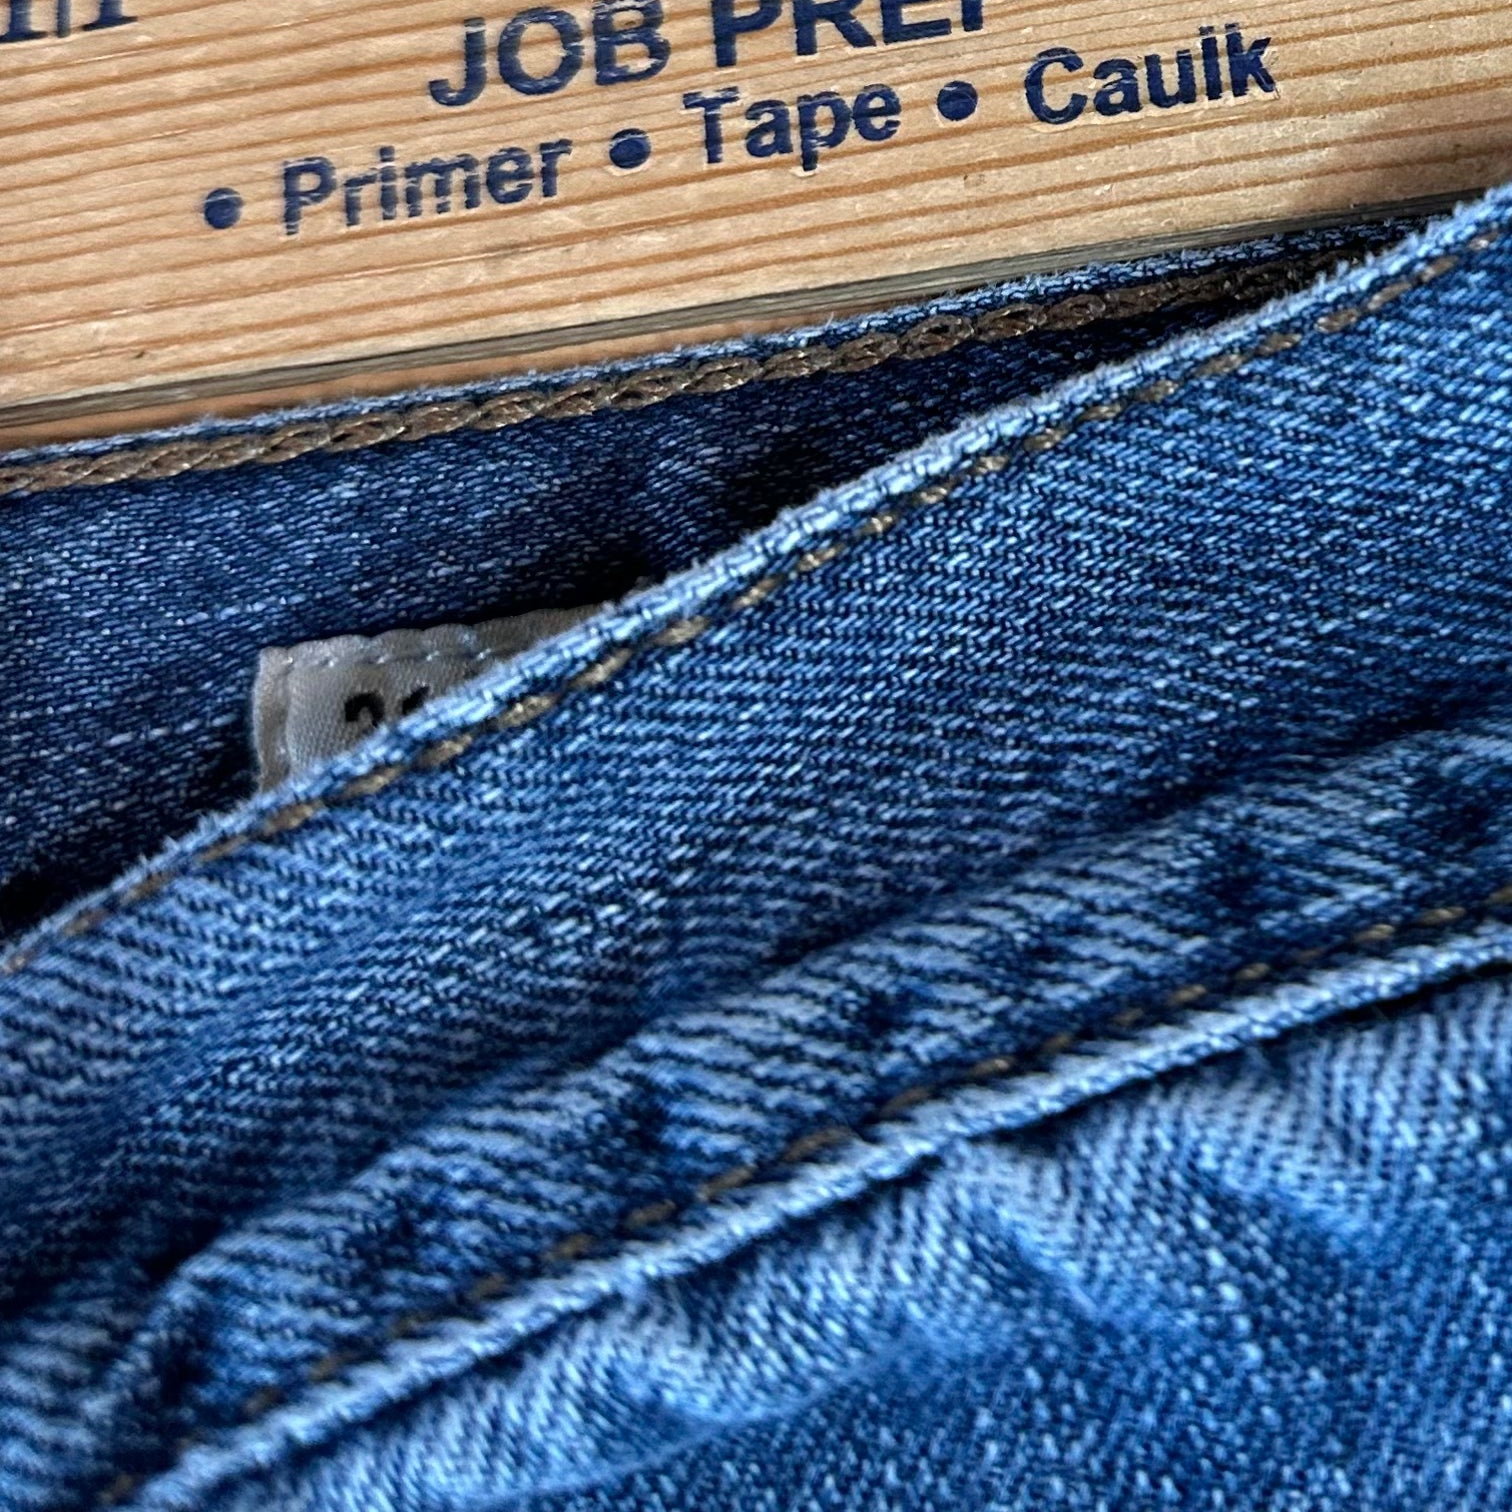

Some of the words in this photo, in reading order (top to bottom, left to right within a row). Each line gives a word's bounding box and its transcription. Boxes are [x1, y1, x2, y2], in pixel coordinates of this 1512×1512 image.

[281, 138, 574, 237] Primer
[682, 84, 902, 172] Tape
[1023, 21, 1278, 126] Caulk
